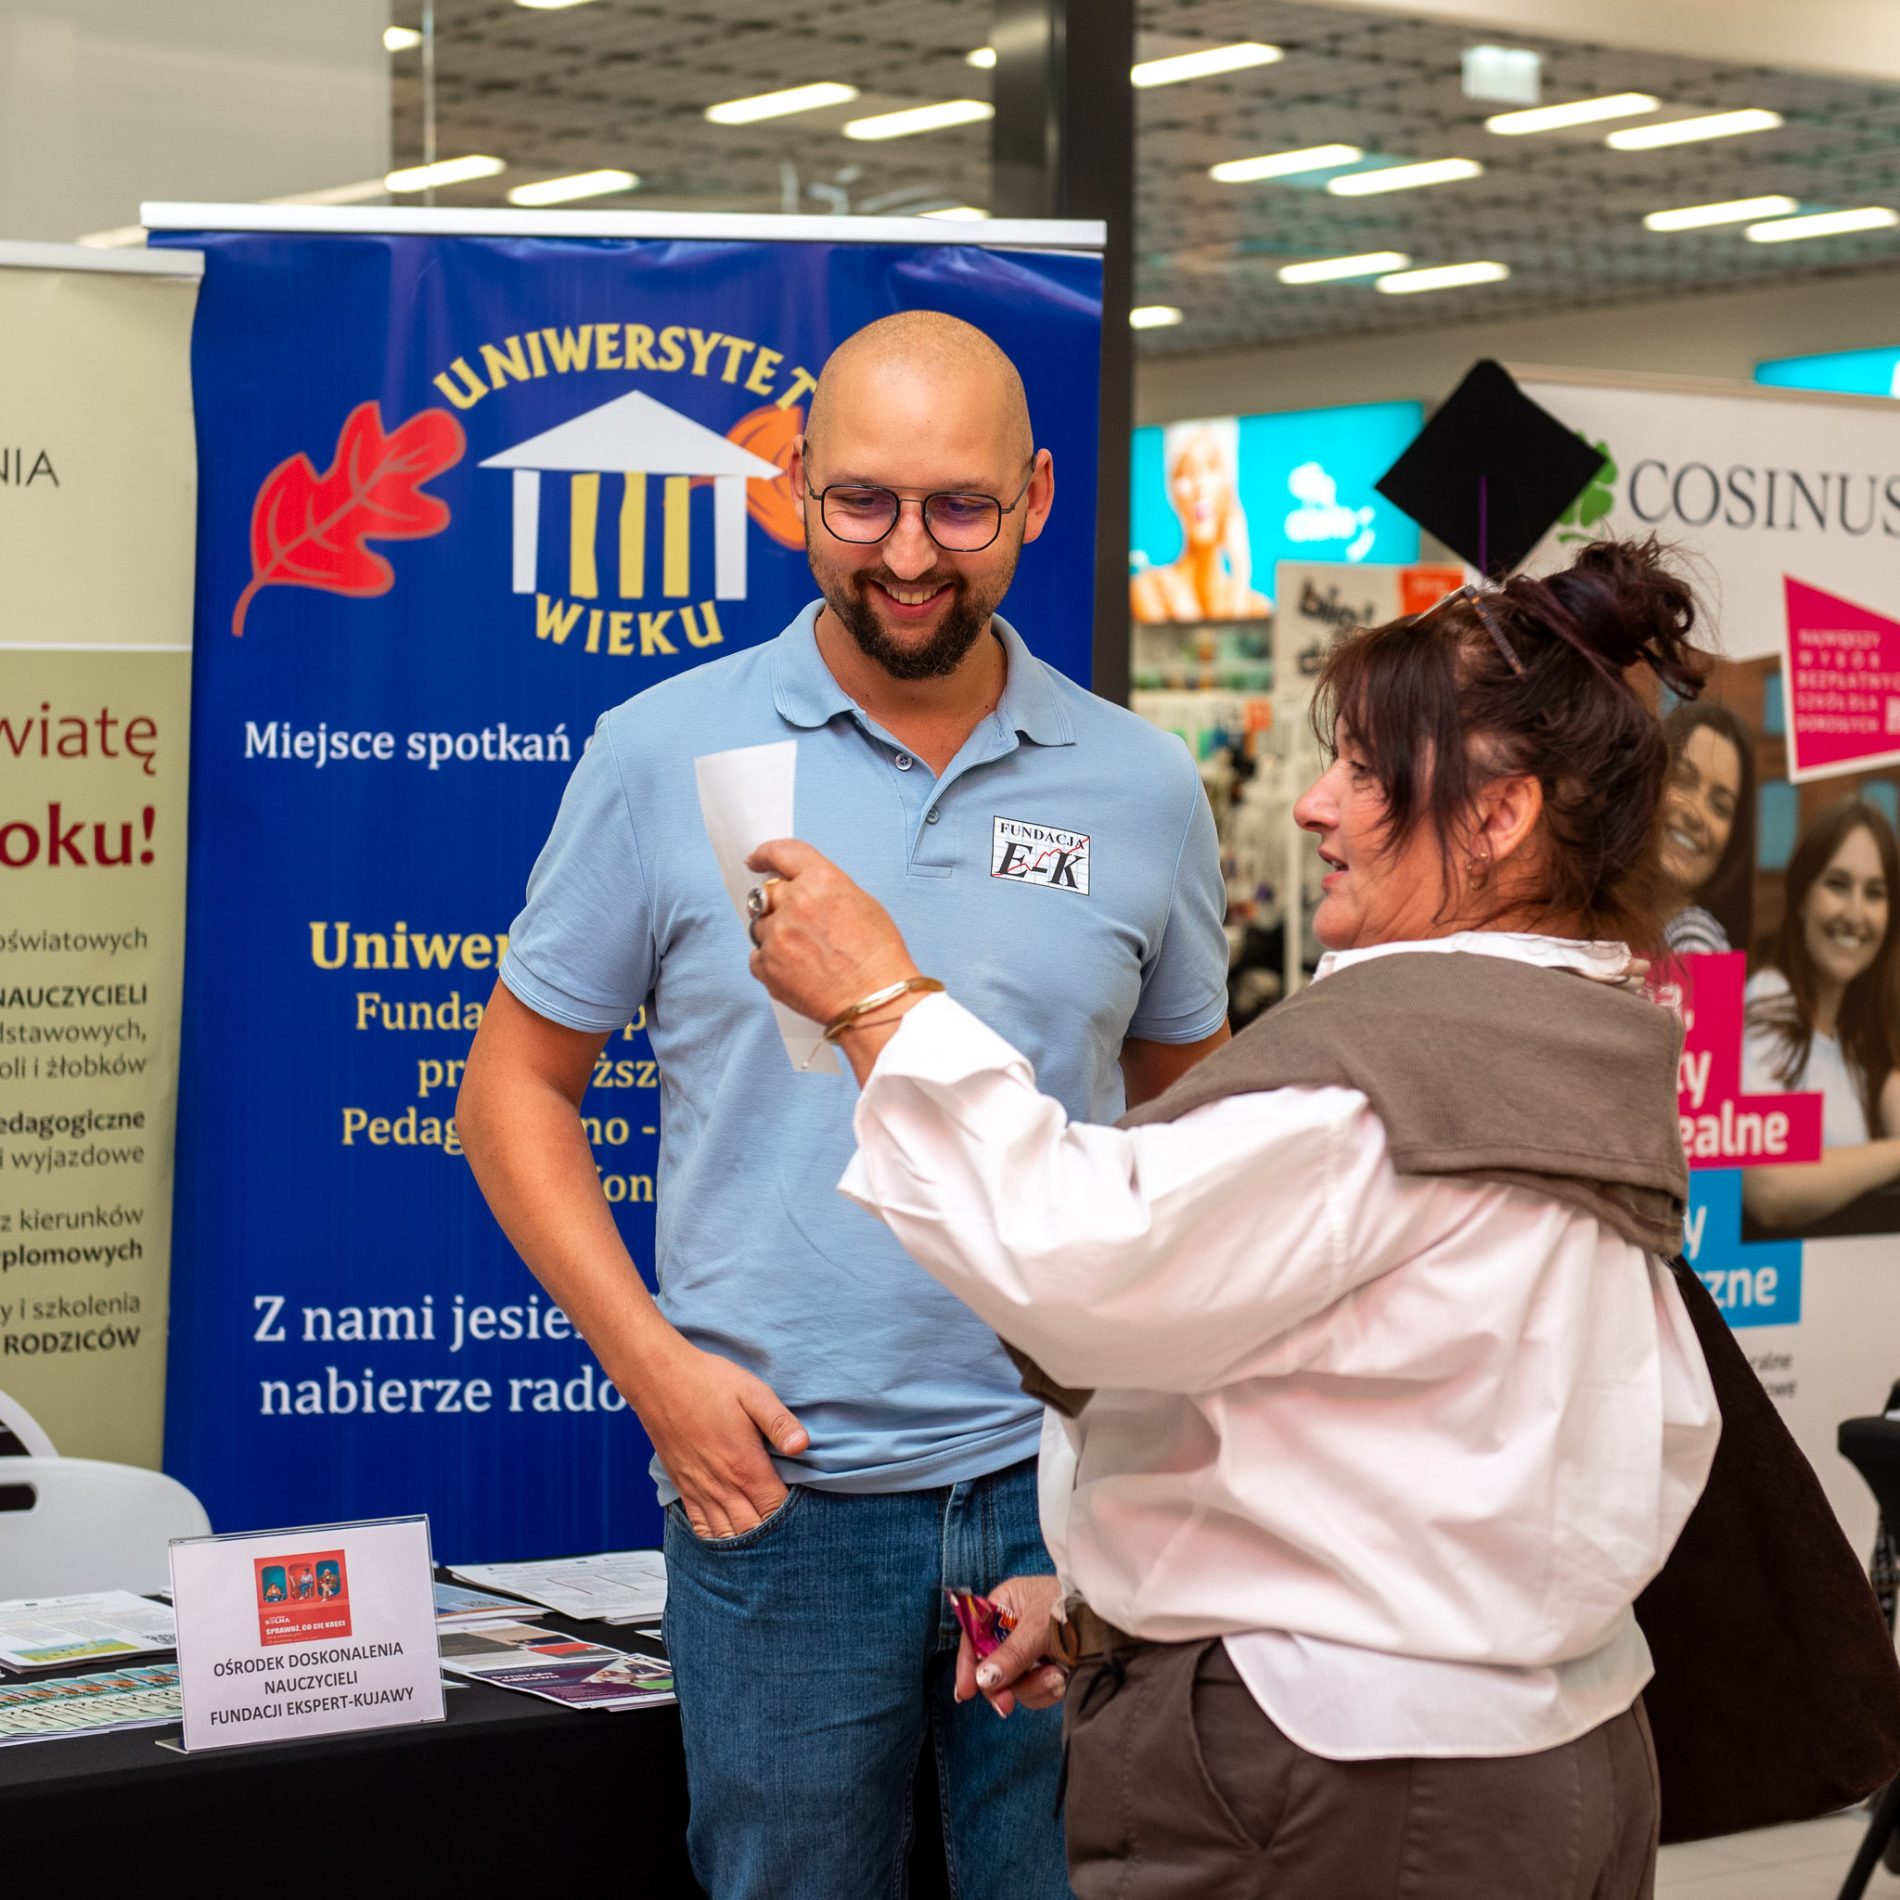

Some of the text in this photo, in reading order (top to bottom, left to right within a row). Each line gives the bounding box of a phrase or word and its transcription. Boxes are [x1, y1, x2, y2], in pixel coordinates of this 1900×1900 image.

[433, 323, 817, 411] UNIWERSYTET
[535, 593, 724, 656] WIEKU
[244, 721, 571, 770] Miejsce spotkań
[0, 803, 156, 867] oku!
[1000, 822, 1085, 849] FUNDACJA
[995, 841, 1086, 889] E-K
[0, 1017, 147, 1047] stawowych,
[47, 1052, 147, 1078] żłobków
[11, 1143, 145, 1174] wyjazdowe
[20, 1204, 144, 1231] kierunków
[0, 1238, 143, 1273] plomowych
[1698, 1266, 1778, 1308] zne
[33, 1292, 140, 1320] szkolenia
[4, 1323, 141, 1355] RODZICÓW
[254, 1296, 583, 1352] Z nami jesie
[260, 1366, 492, 1415] nabierze
[213, 1642, 404, 1677] OŚRODEK DOSKONALENIA
[264, 1671, 358, 1695] NAUCZYCIELI
[210, 1687, 414, 1726] FUNDACJI EKSPERT-KUJAWY
